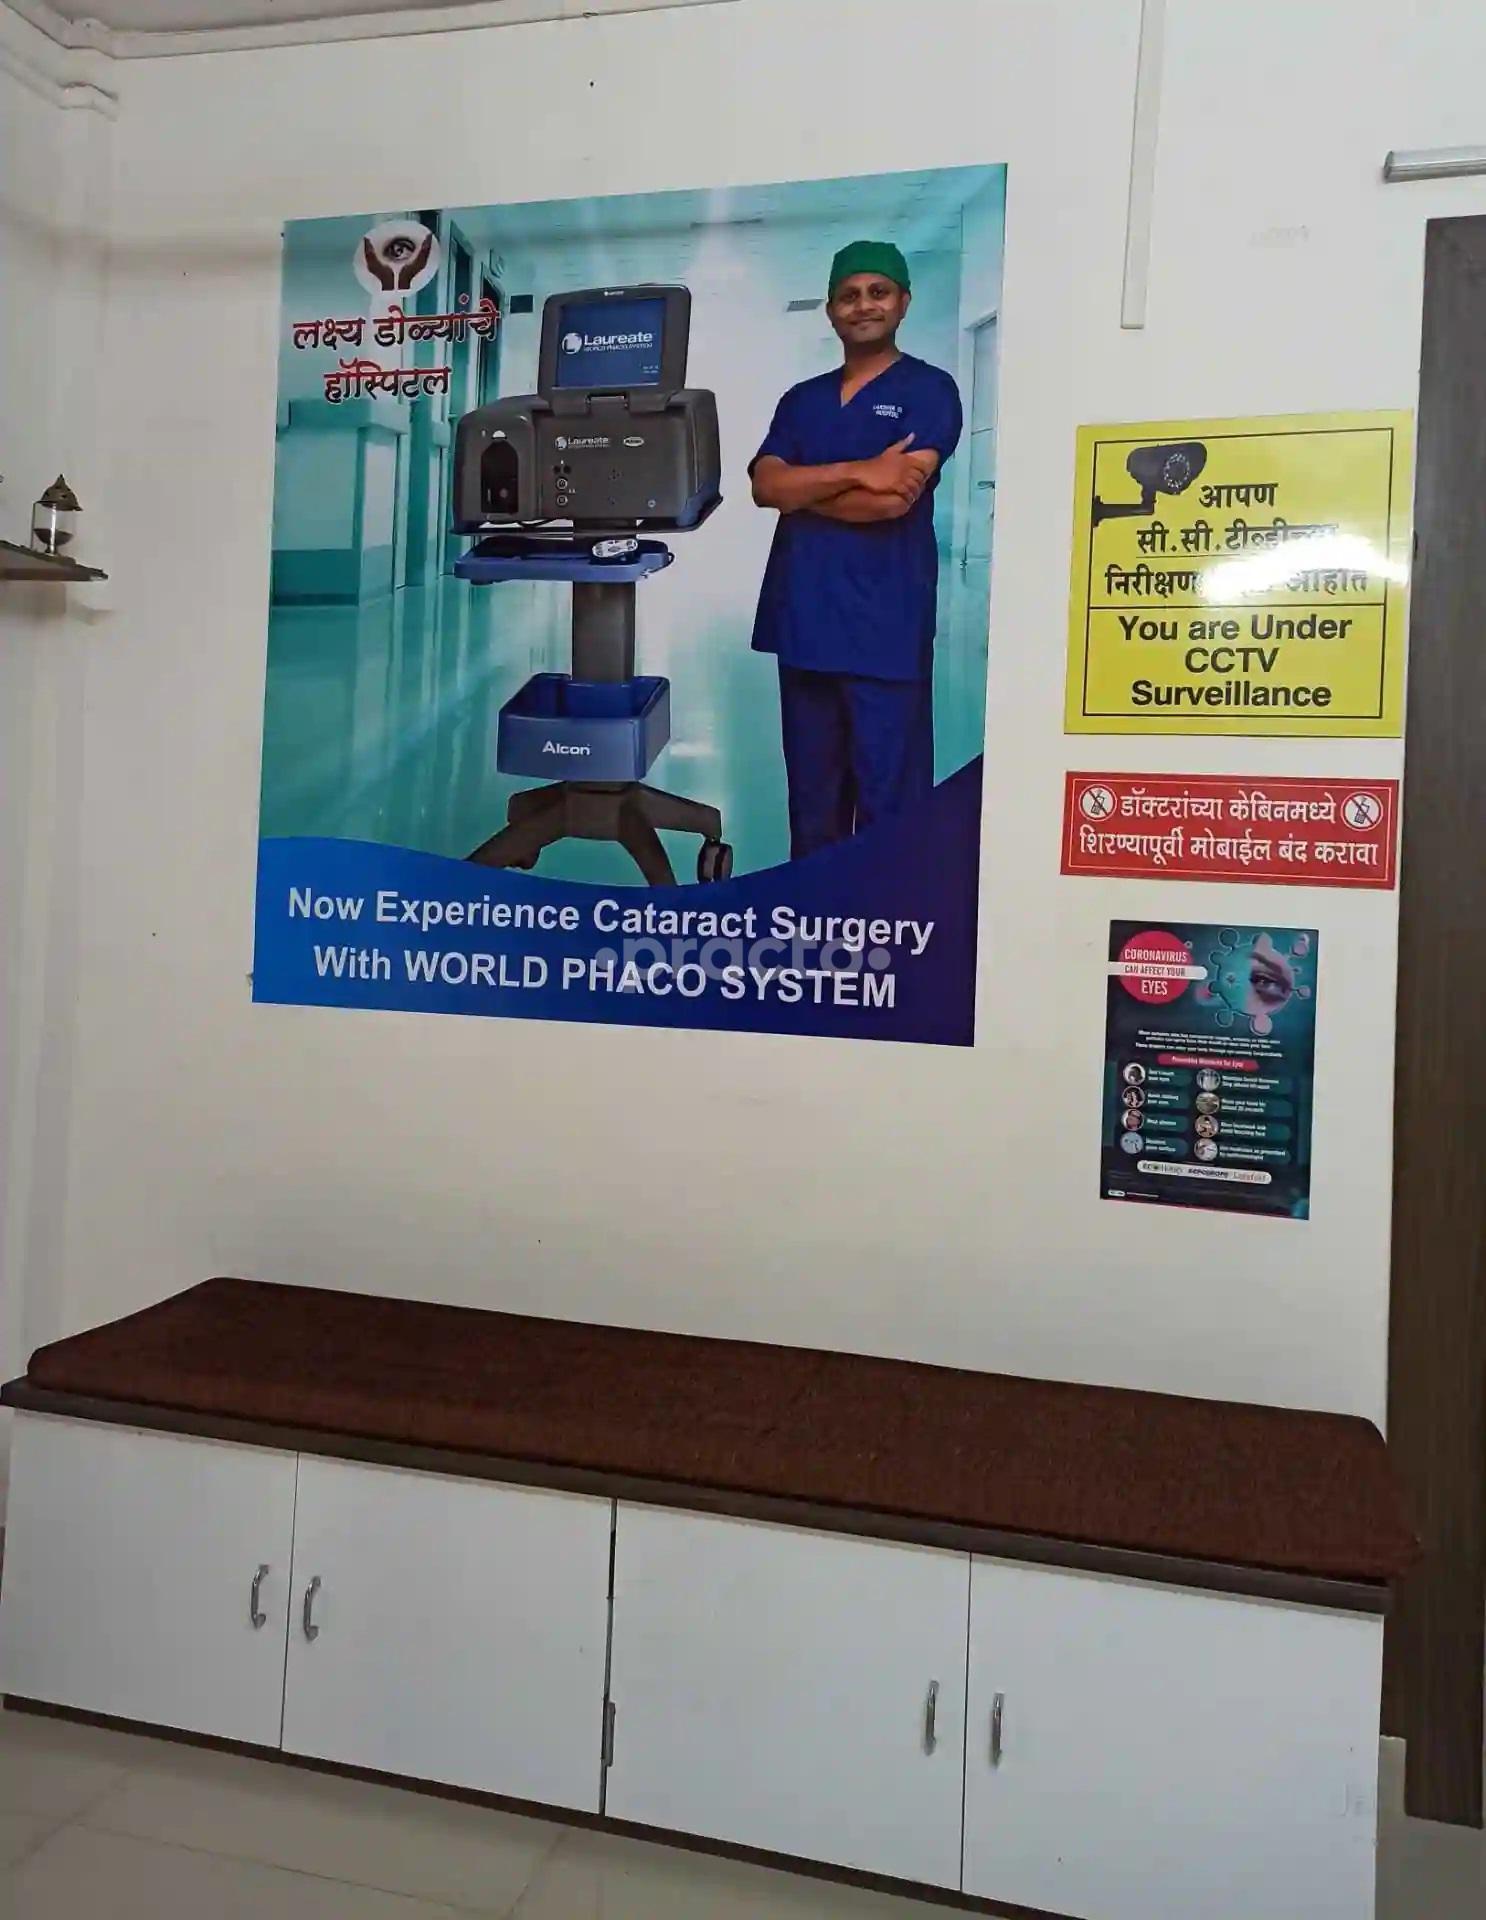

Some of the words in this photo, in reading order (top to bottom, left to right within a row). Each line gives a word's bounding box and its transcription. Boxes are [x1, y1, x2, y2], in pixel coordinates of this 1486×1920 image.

[293, 319, 366, 350] लक्ष्य
[373, 293, 501, 348] डोळ्यांचे
[584, 331, 653, 346] Laureate
[323, 357, 451, 403] हॉस्पिटल
[1199, 482, 1278, 508] आपण
[1118, 615, 1178, 641] You
[1188, 619, 1240, 640] are
[1251, 613, 1352, 640] Under
[1184, 647, 1279, 674] CCTV
[1131, 679, 1332, 707] Surveillance
[542, 740, 591, 756] Alcon
[1120, 787, 1223, 821] डॉक्टरांच्या
[1229, 789, 1337, 824] केबिनमध्ये
[1190, 827, 1271, 866] मोबाईल
[1278, 833, 1307, 863] बंद
[1314, 841, 1379, 866] करावा
[288, 886, 365, 921] Now
[376, 890, 579, 932] Experience
[593, 899, 757, 939] Cataract
[770, 906, 935, 956] Surgery
[1124, 948, 1188, 963] CORONAVIRUS
[313, 945, 391, 980] With
[403, 949, 548, 988] WORLD
[562, 957, 706, 997] PHACO
[720, 964, 896, 1009] SYSTEM
[1124, 965, 1139, 976] CAN
[1140, 965, 1165, 976] AFFECT
[1167, 966, 1185, 976] YOUR
[1141, 979, 1168, 995] EYES
